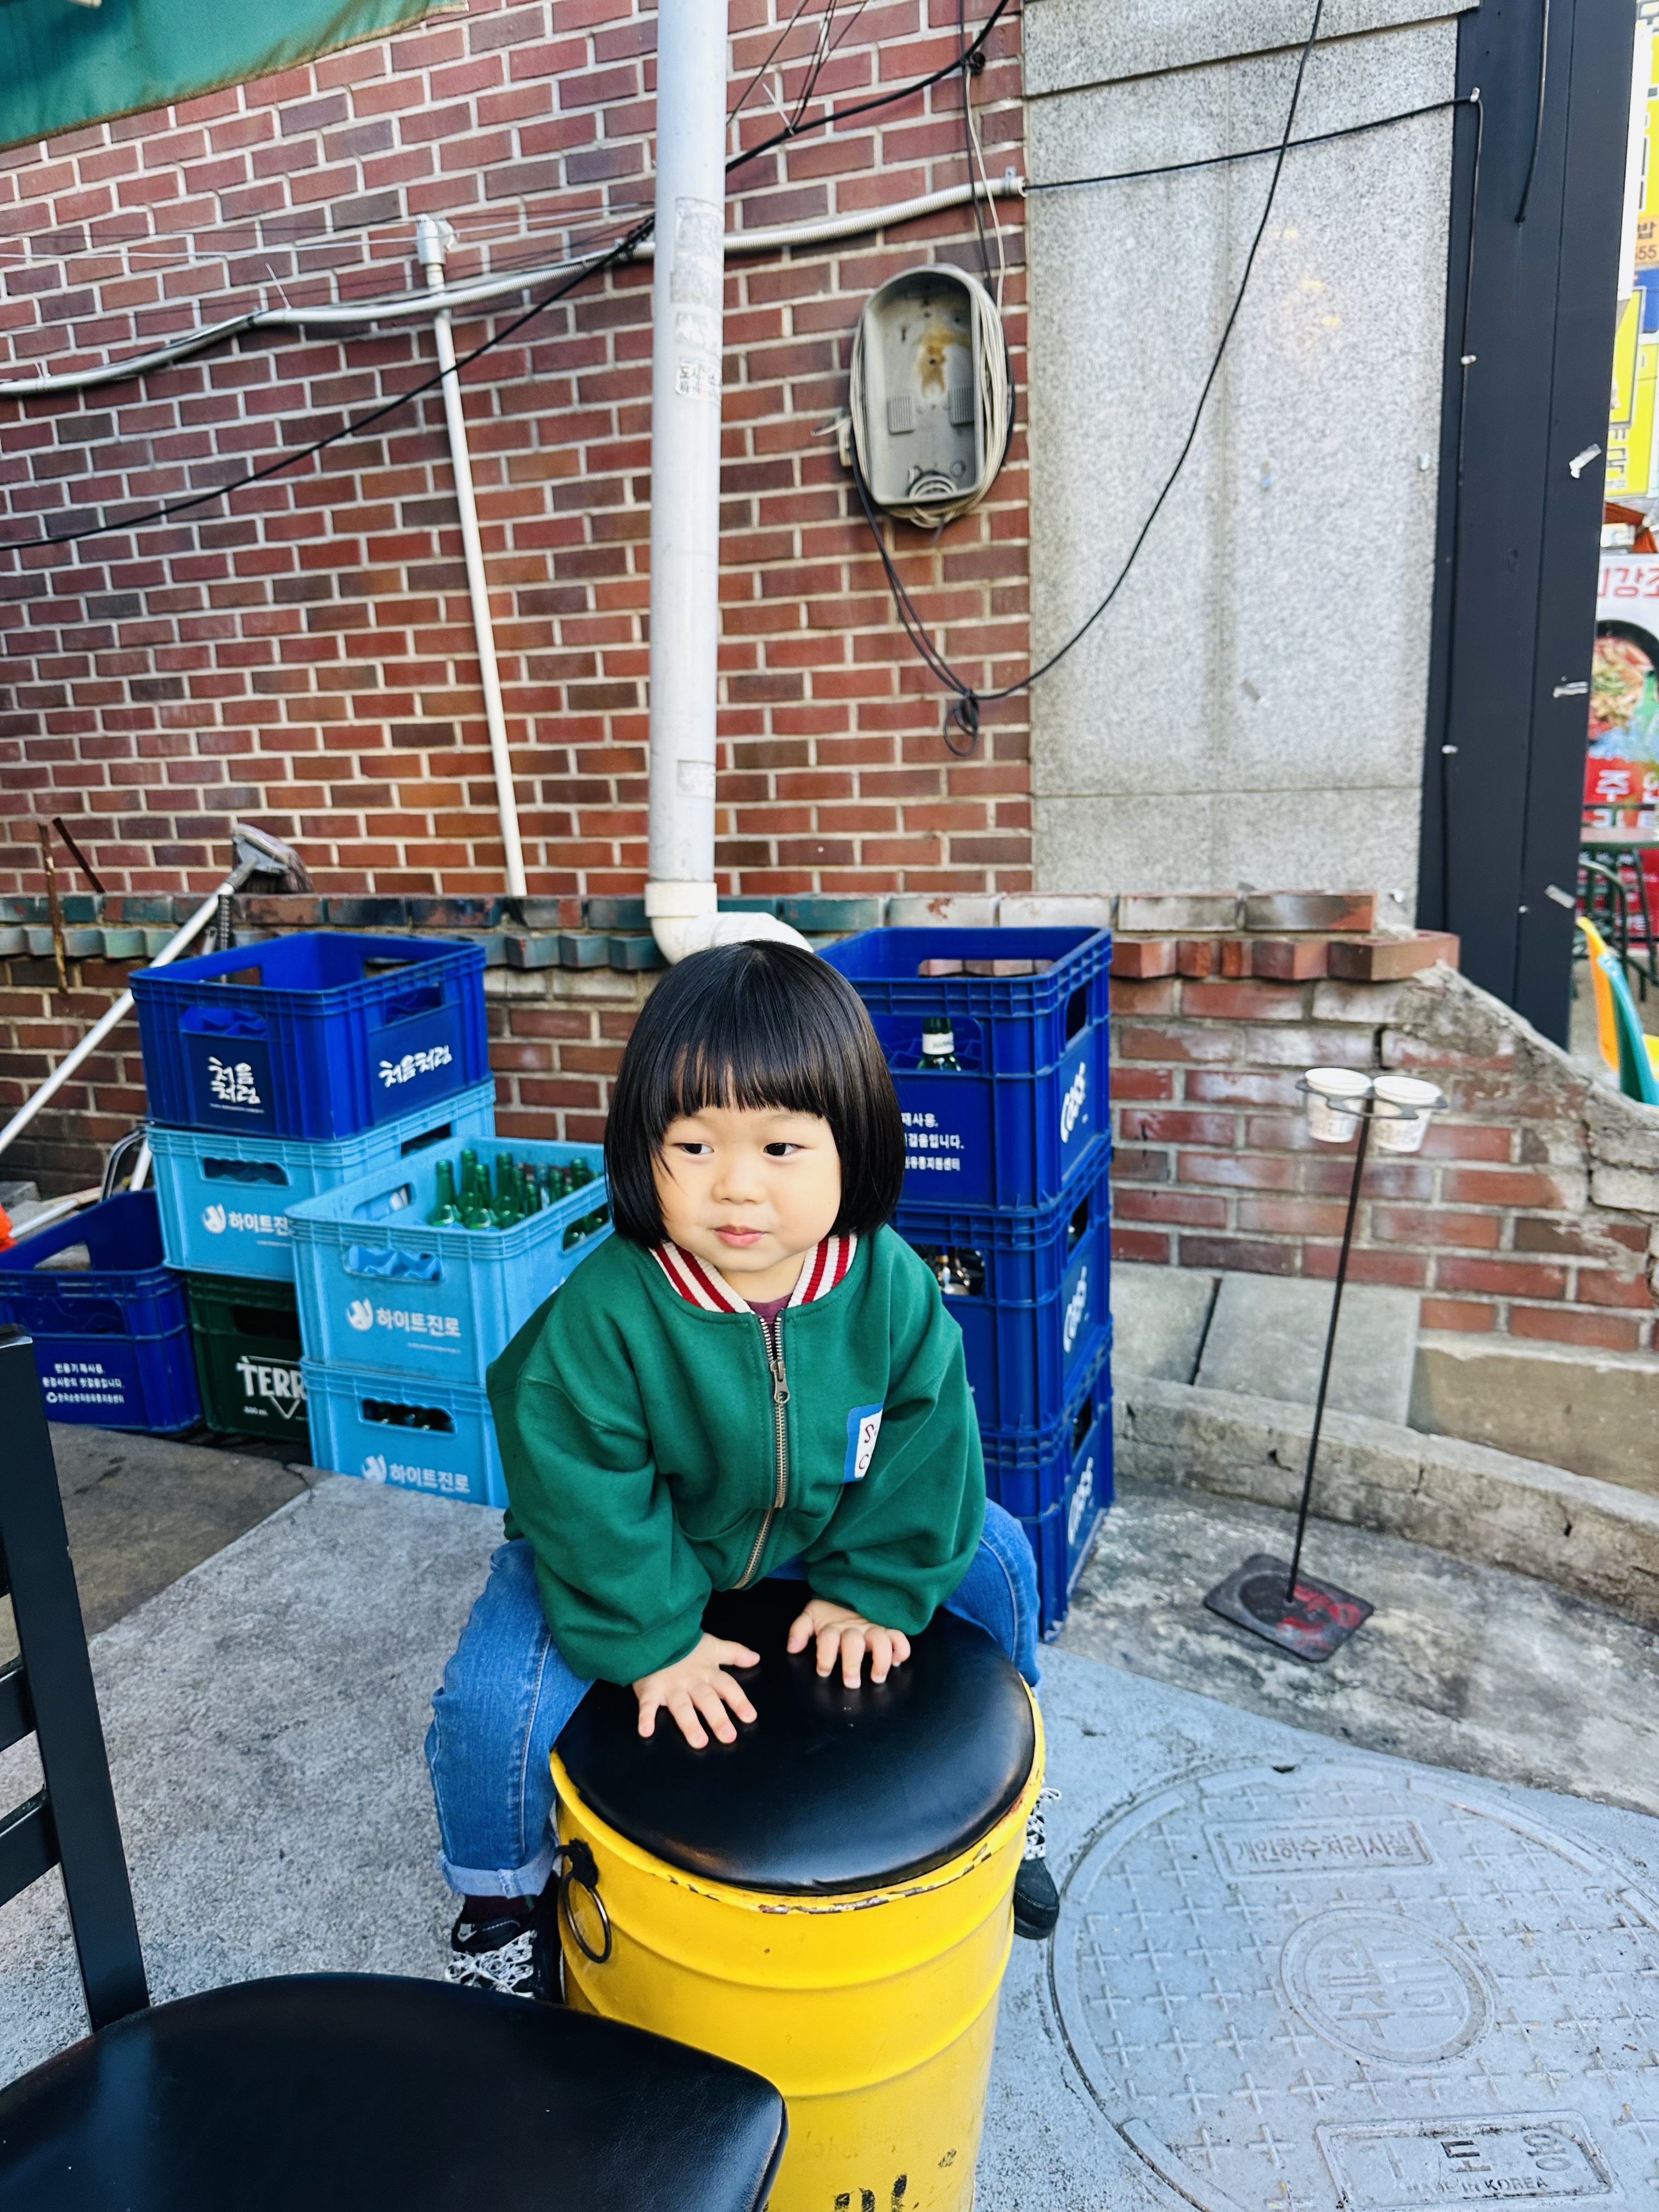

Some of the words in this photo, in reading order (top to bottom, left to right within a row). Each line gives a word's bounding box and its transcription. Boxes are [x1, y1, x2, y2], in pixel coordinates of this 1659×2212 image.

[379, 1045, 453, 1088] 처음처럼
[904, 1132, 965, 1150] 걸음입니다.
[228, 1211, 291, 1237] 하이트진
[376, 1307, 461, 1338] 하이트진로
[236, 1362, 308, 1401] TERR
[388, 1463, 471, 1494] 하이트진로
[1237, 1829, 1414, 1865] 개인하수처리시설
[1484, 2176, 1548, 2191] KOREA
